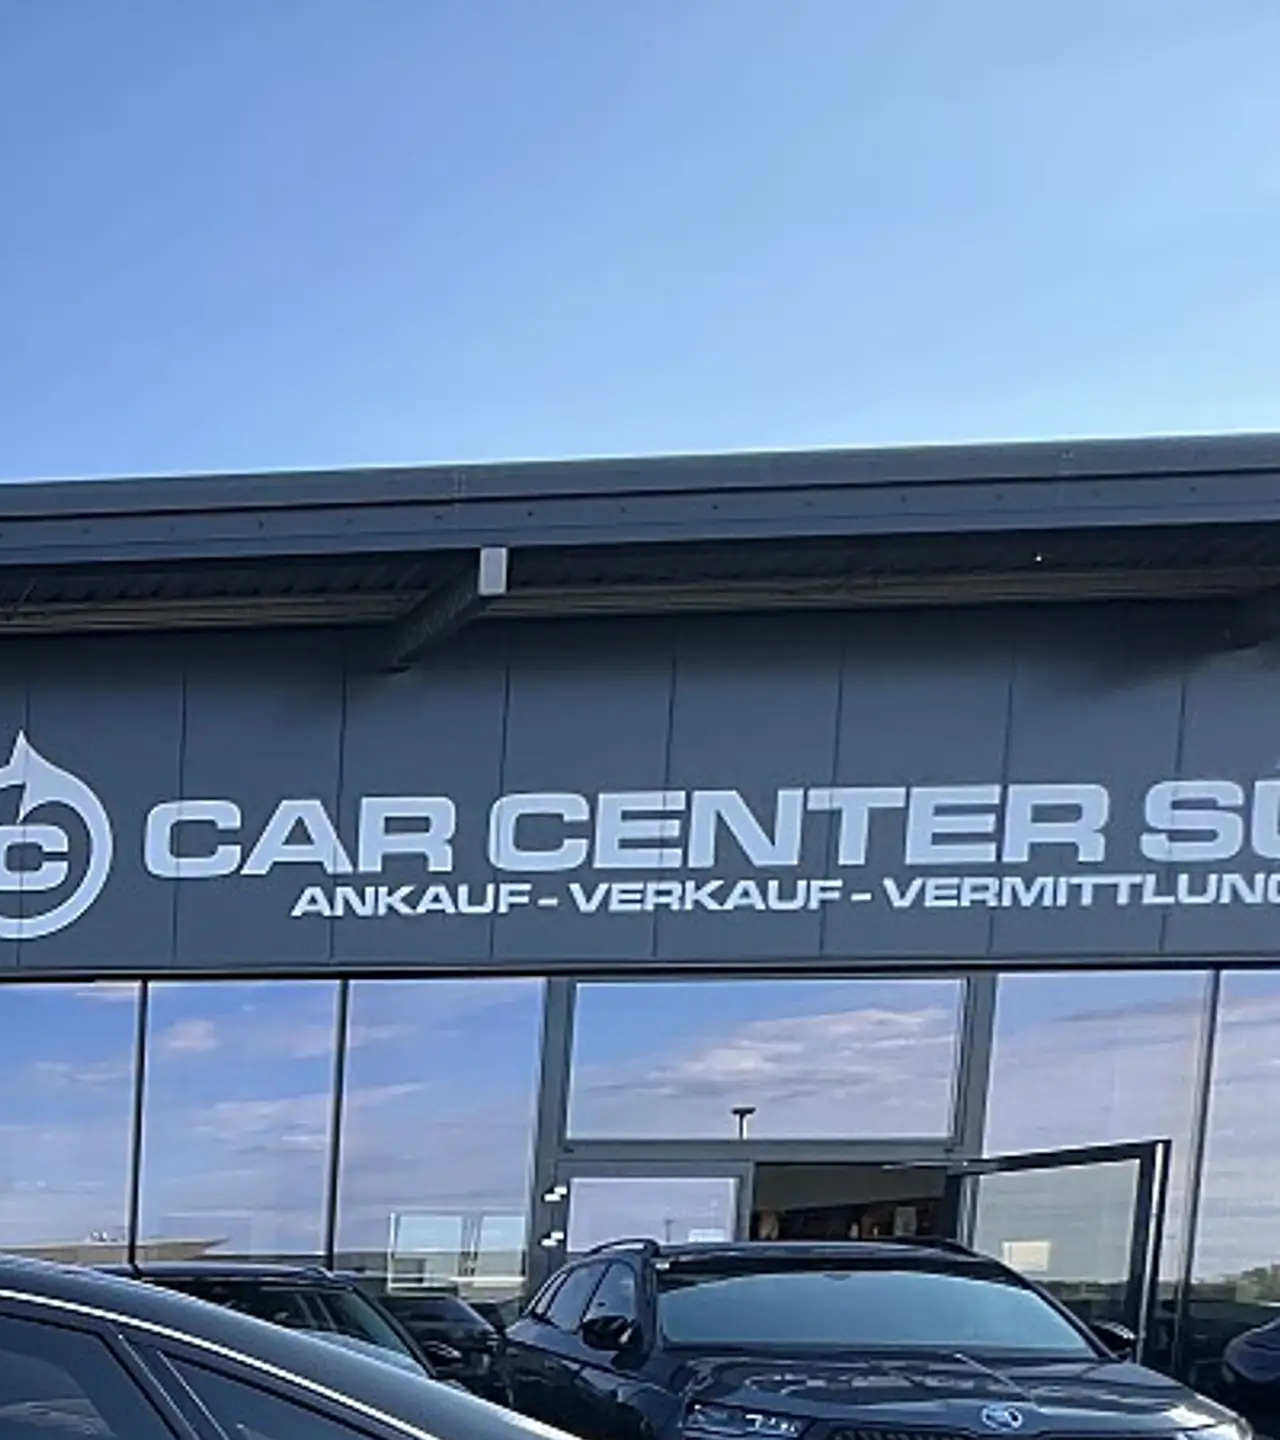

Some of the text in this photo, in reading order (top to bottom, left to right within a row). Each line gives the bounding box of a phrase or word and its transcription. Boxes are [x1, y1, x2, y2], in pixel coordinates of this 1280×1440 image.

[145, 770, 1280, 877] CAR CENTER S
[291, 883, 532, 916] ANKAUF
[568, 879, 843, 911] VERKAUF
[882, 873, 1280, 908] VERMITTLUN
